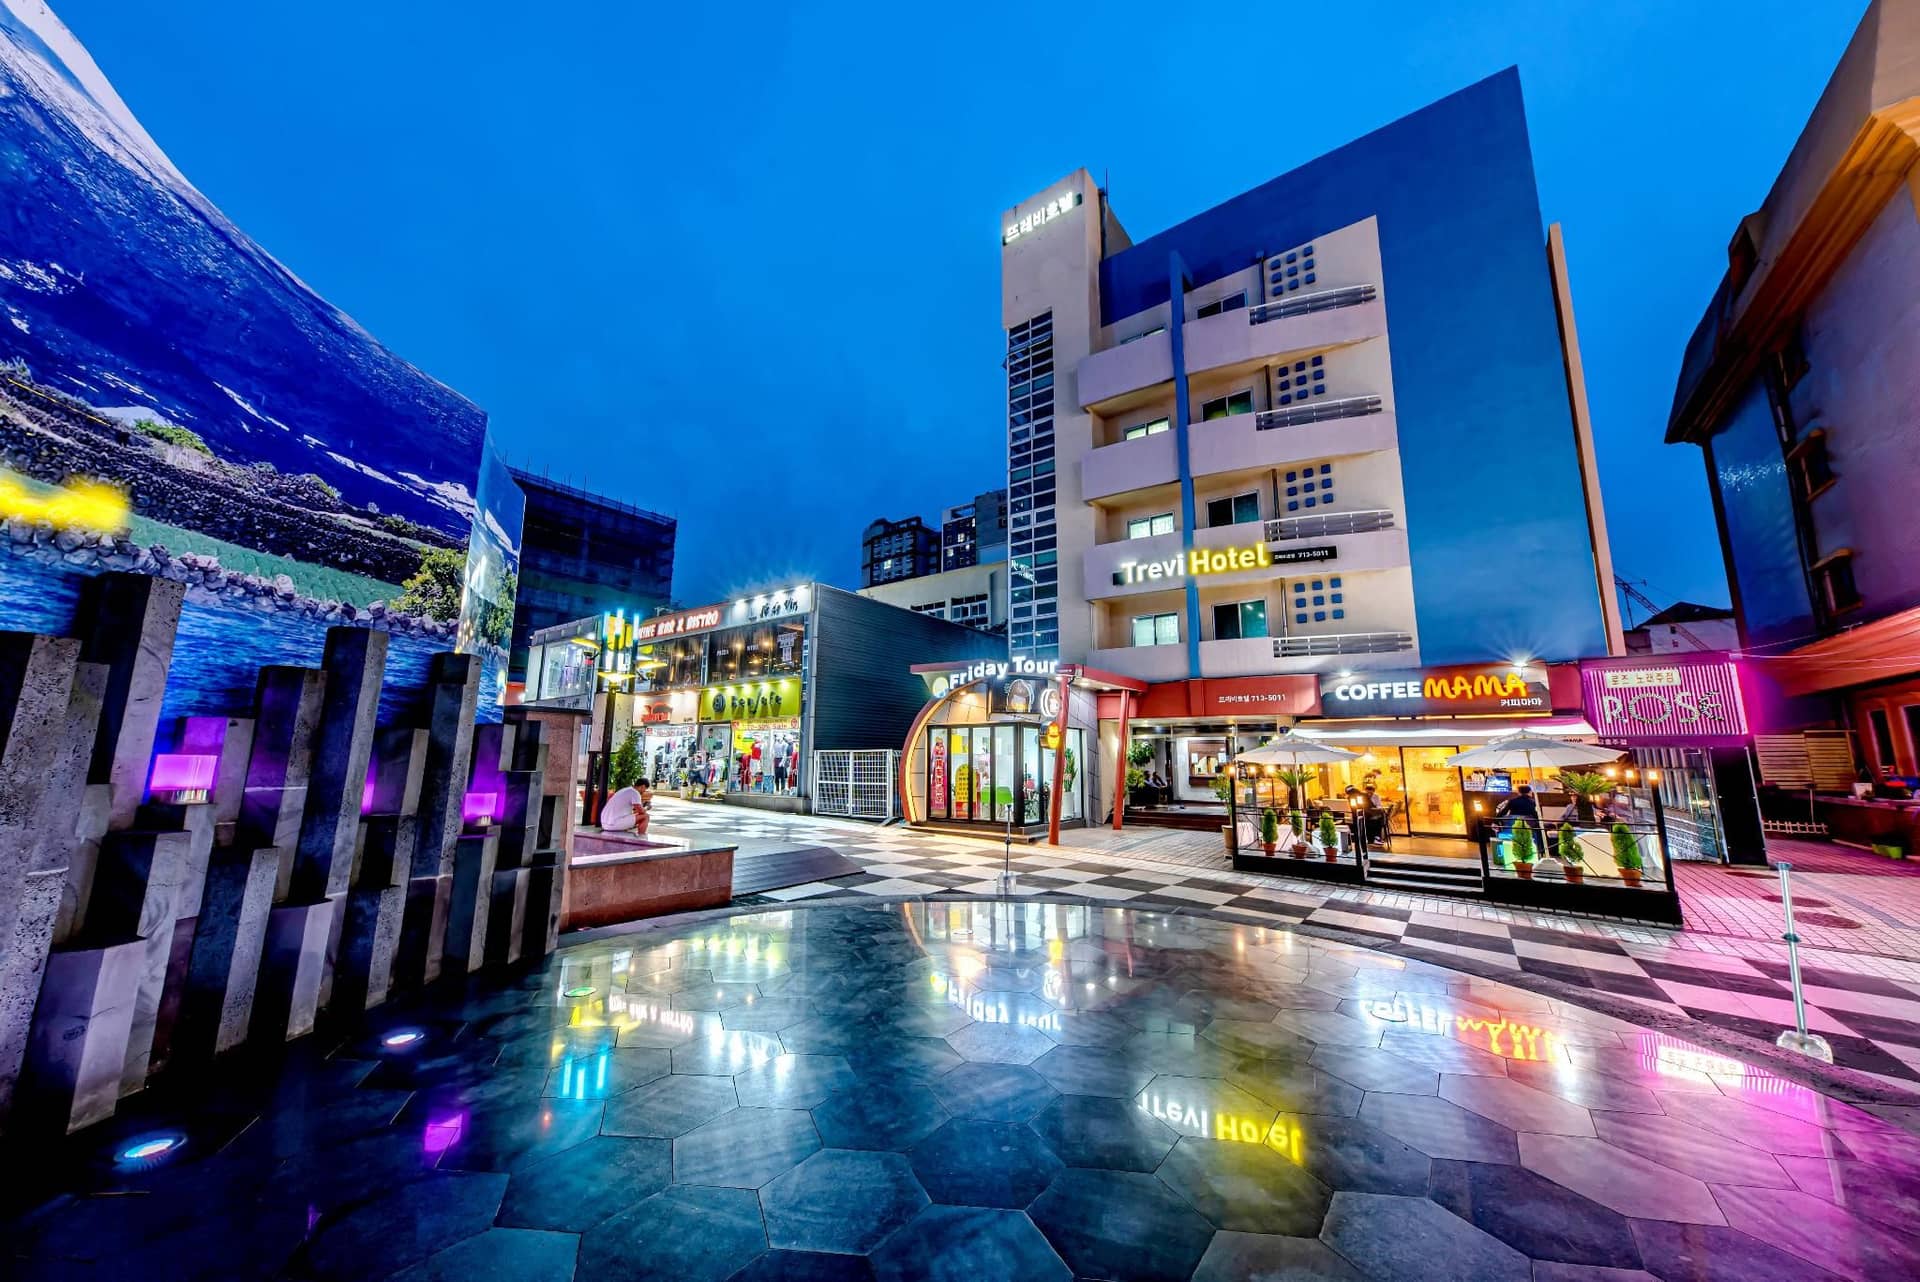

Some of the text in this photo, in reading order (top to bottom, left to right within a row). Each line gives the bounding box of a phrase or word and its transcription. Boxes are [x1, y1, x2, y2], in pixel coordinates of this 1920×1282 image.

[1121, 543, 1268, 583] Trevi Hotel
[686, 610, 719, 630] BISTRO
[949, 656, 1058, 689] Friday Tour
[1611, 674, 1630, 685] 로즈
[1251, 694, 1286, 702] 713-5011
[1335, 673, 1528, 701] COFFEE MAMA
[1500, 698, 1542, 706] 커피마마
[1602, 691, 1725, 725] ROSE
